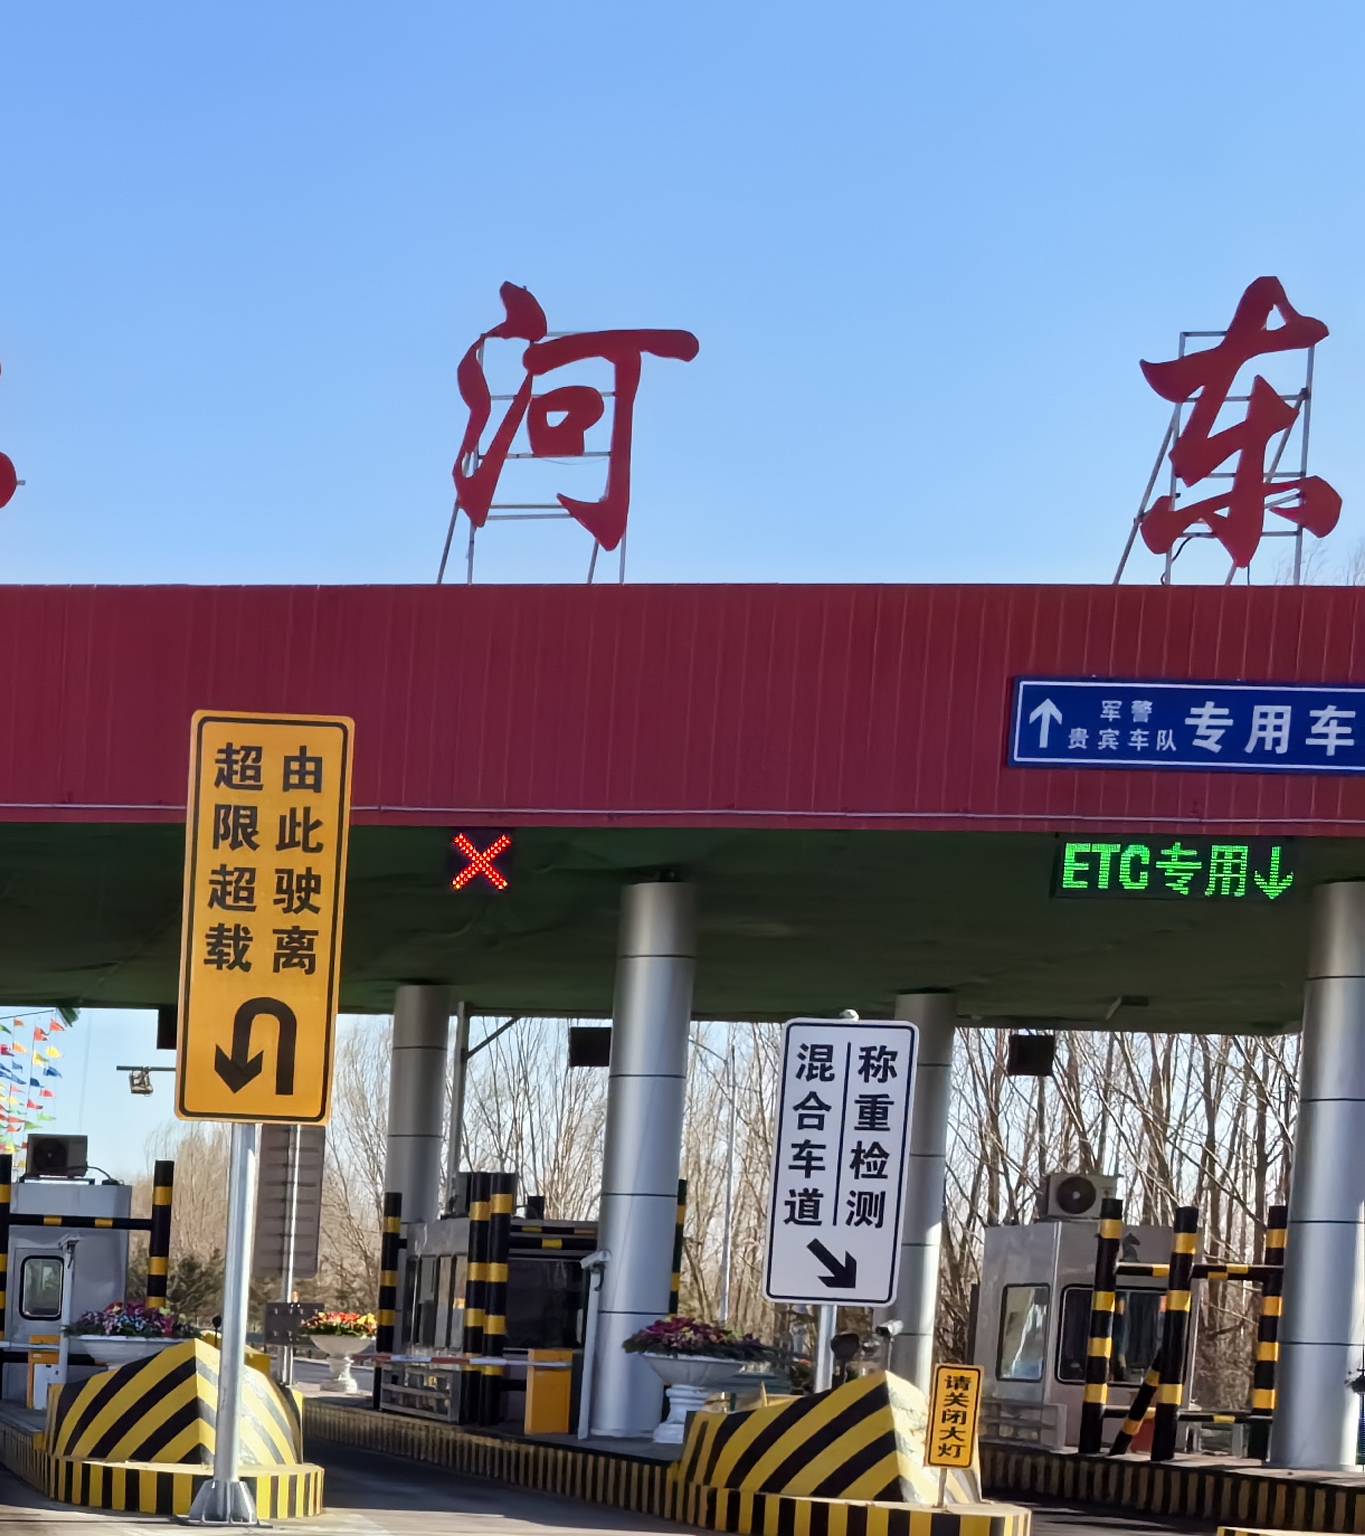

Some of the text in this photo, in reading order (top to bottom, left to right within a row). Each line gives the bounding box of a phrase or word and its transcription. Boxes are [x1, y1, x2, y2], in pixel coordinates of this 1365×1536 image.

[1067, 728, 1177, 752] 贵宾车队
[1100, 700, 1153, 723] 军警
[1184, 701, 1357, 757] 专用车
[203, 742, 264, 973] 超限超载
[272, 745, 324, 976] 由此驶离
[1062, 841, 1250, 897] ETC专用
[784, 1043, 835, 1227] 混合车道
[846, 1043, 898, 1230] 称重检测
[937, 1374, 971, 1458] 请关闭大灯
